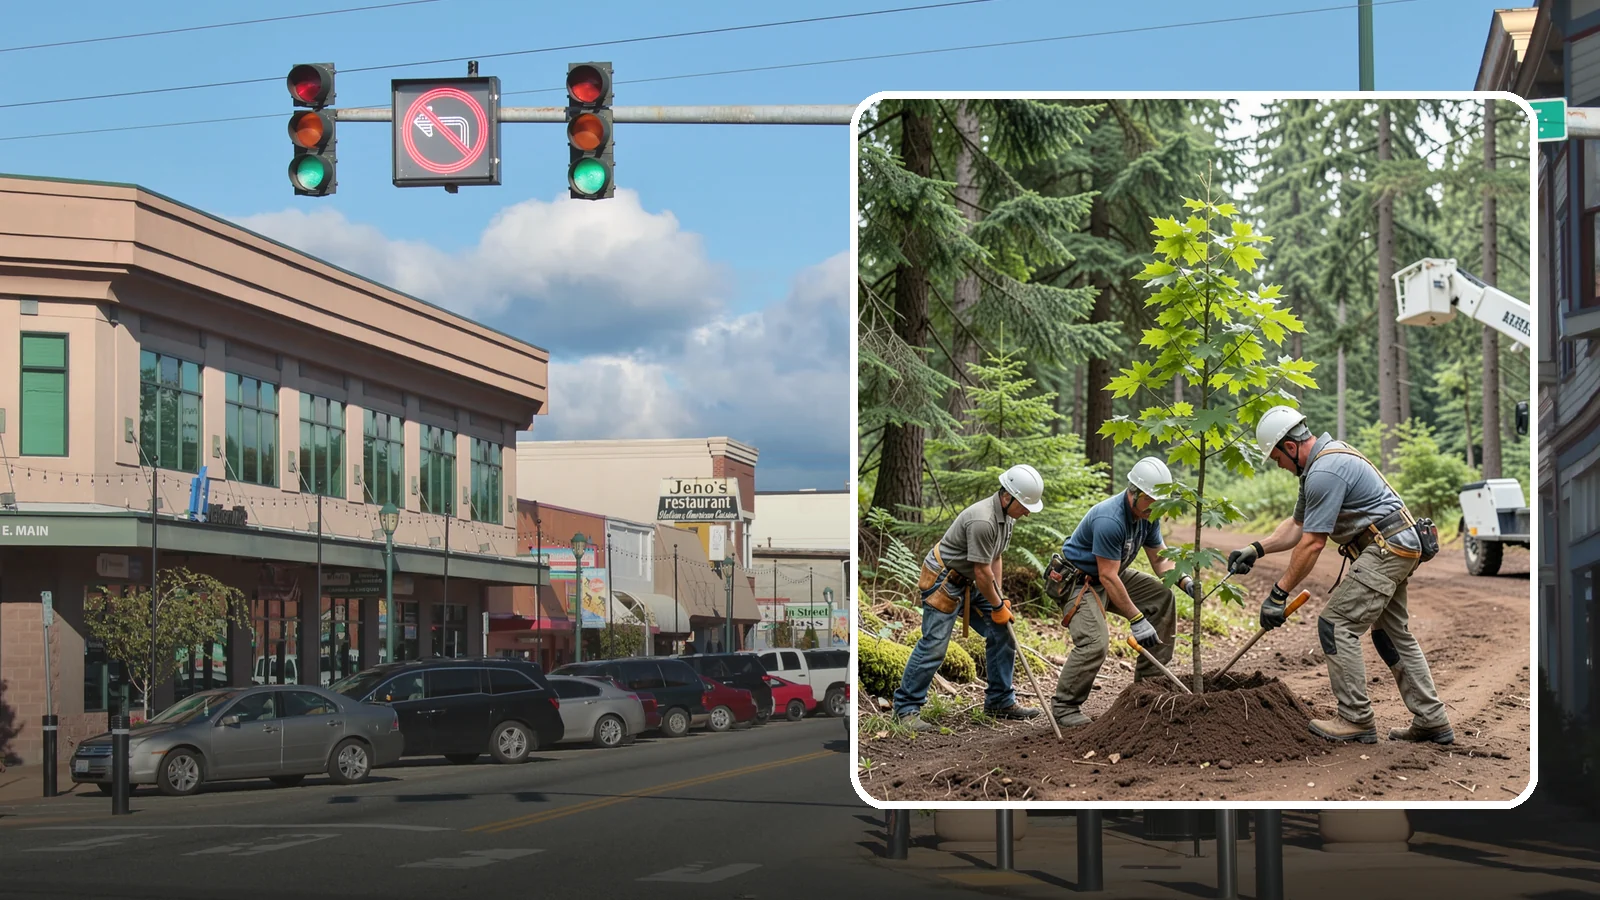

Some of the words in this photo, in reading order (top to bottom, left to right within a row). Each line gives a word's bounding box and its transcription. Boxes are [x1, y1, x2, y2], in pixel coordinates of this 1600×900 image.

[669, 480, 728, 494] Jeno's
[665, 496, 731, 509] restaurant
[658, 509, 682, 520] Italian
[686, 509, 715, 519] American
[715, 509, 738, 519] Cuisine
[2, 525, 13, 536] E.
[15, 525, 49, 536] MAIN
[797, 607, 829, 617] Street
[790, 619, 823, 627] lass
